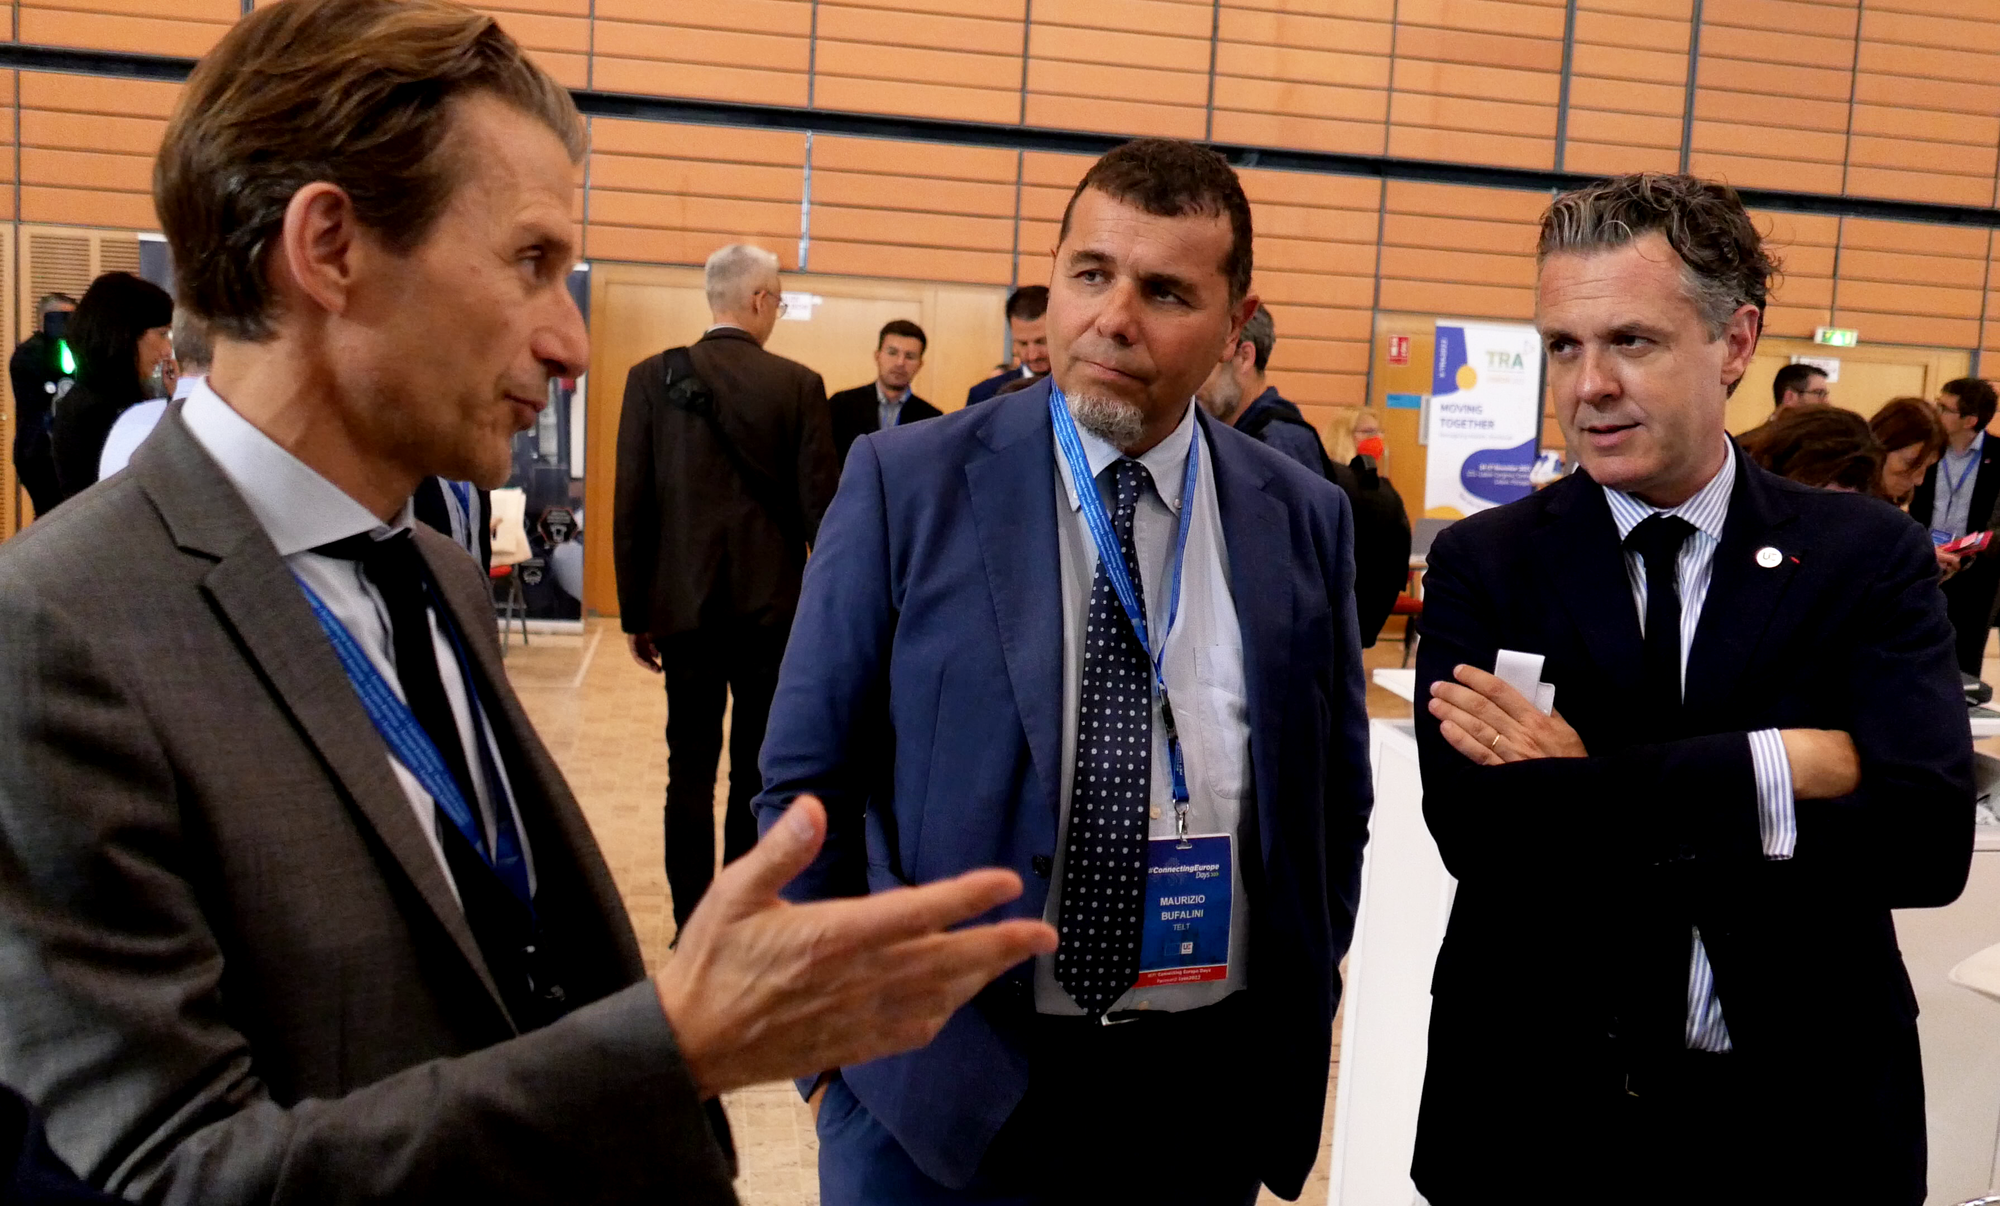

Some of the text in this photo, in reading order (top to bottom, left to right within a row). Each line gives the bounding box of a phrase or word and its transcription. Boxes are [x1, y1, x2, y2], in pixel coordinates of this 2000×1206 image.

[1486, 350, 1524, 370] TRA
[1440, 403, 1483, 415] MOVING
[1440, 417, 1495, 430] TOGETHER
[1148, 864, 1220, 874] #ConnectingEurope
[1160, 894, 1206, 906] MAURIZIO
[1161, 909, 1204, 921] BUFALINI
